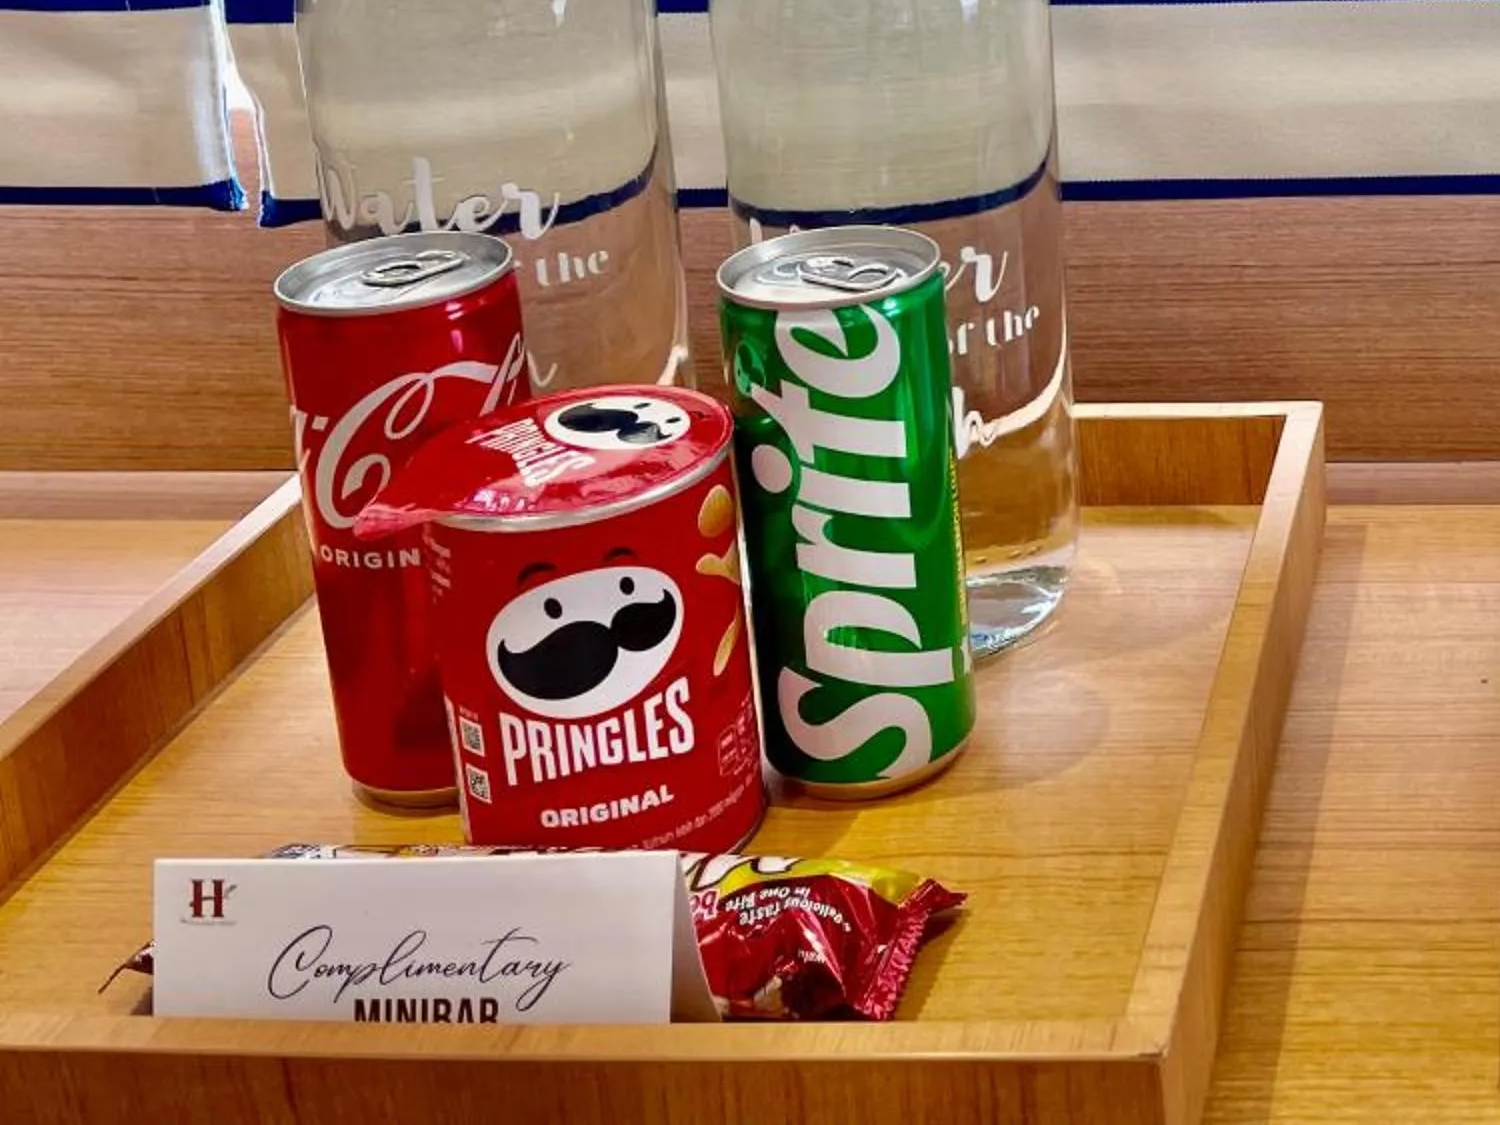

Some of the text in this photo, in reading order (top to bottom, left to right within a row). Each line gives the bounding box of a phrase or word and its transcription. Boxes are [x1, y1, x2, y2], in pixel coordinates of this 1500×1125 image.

[313, 149, 560, 240] Water
[536, 251, 609, 287] the
[986, 305, 1041, 348] the
[318, 544, 421, 569] ORIGIN
[751, 304, 955, 779] Sprite
[500, 677, 695, 786] PRINGLES
[541, 784, 674, 828] ORIGINAL
[267, 924, 572, 1012] Complimentary
